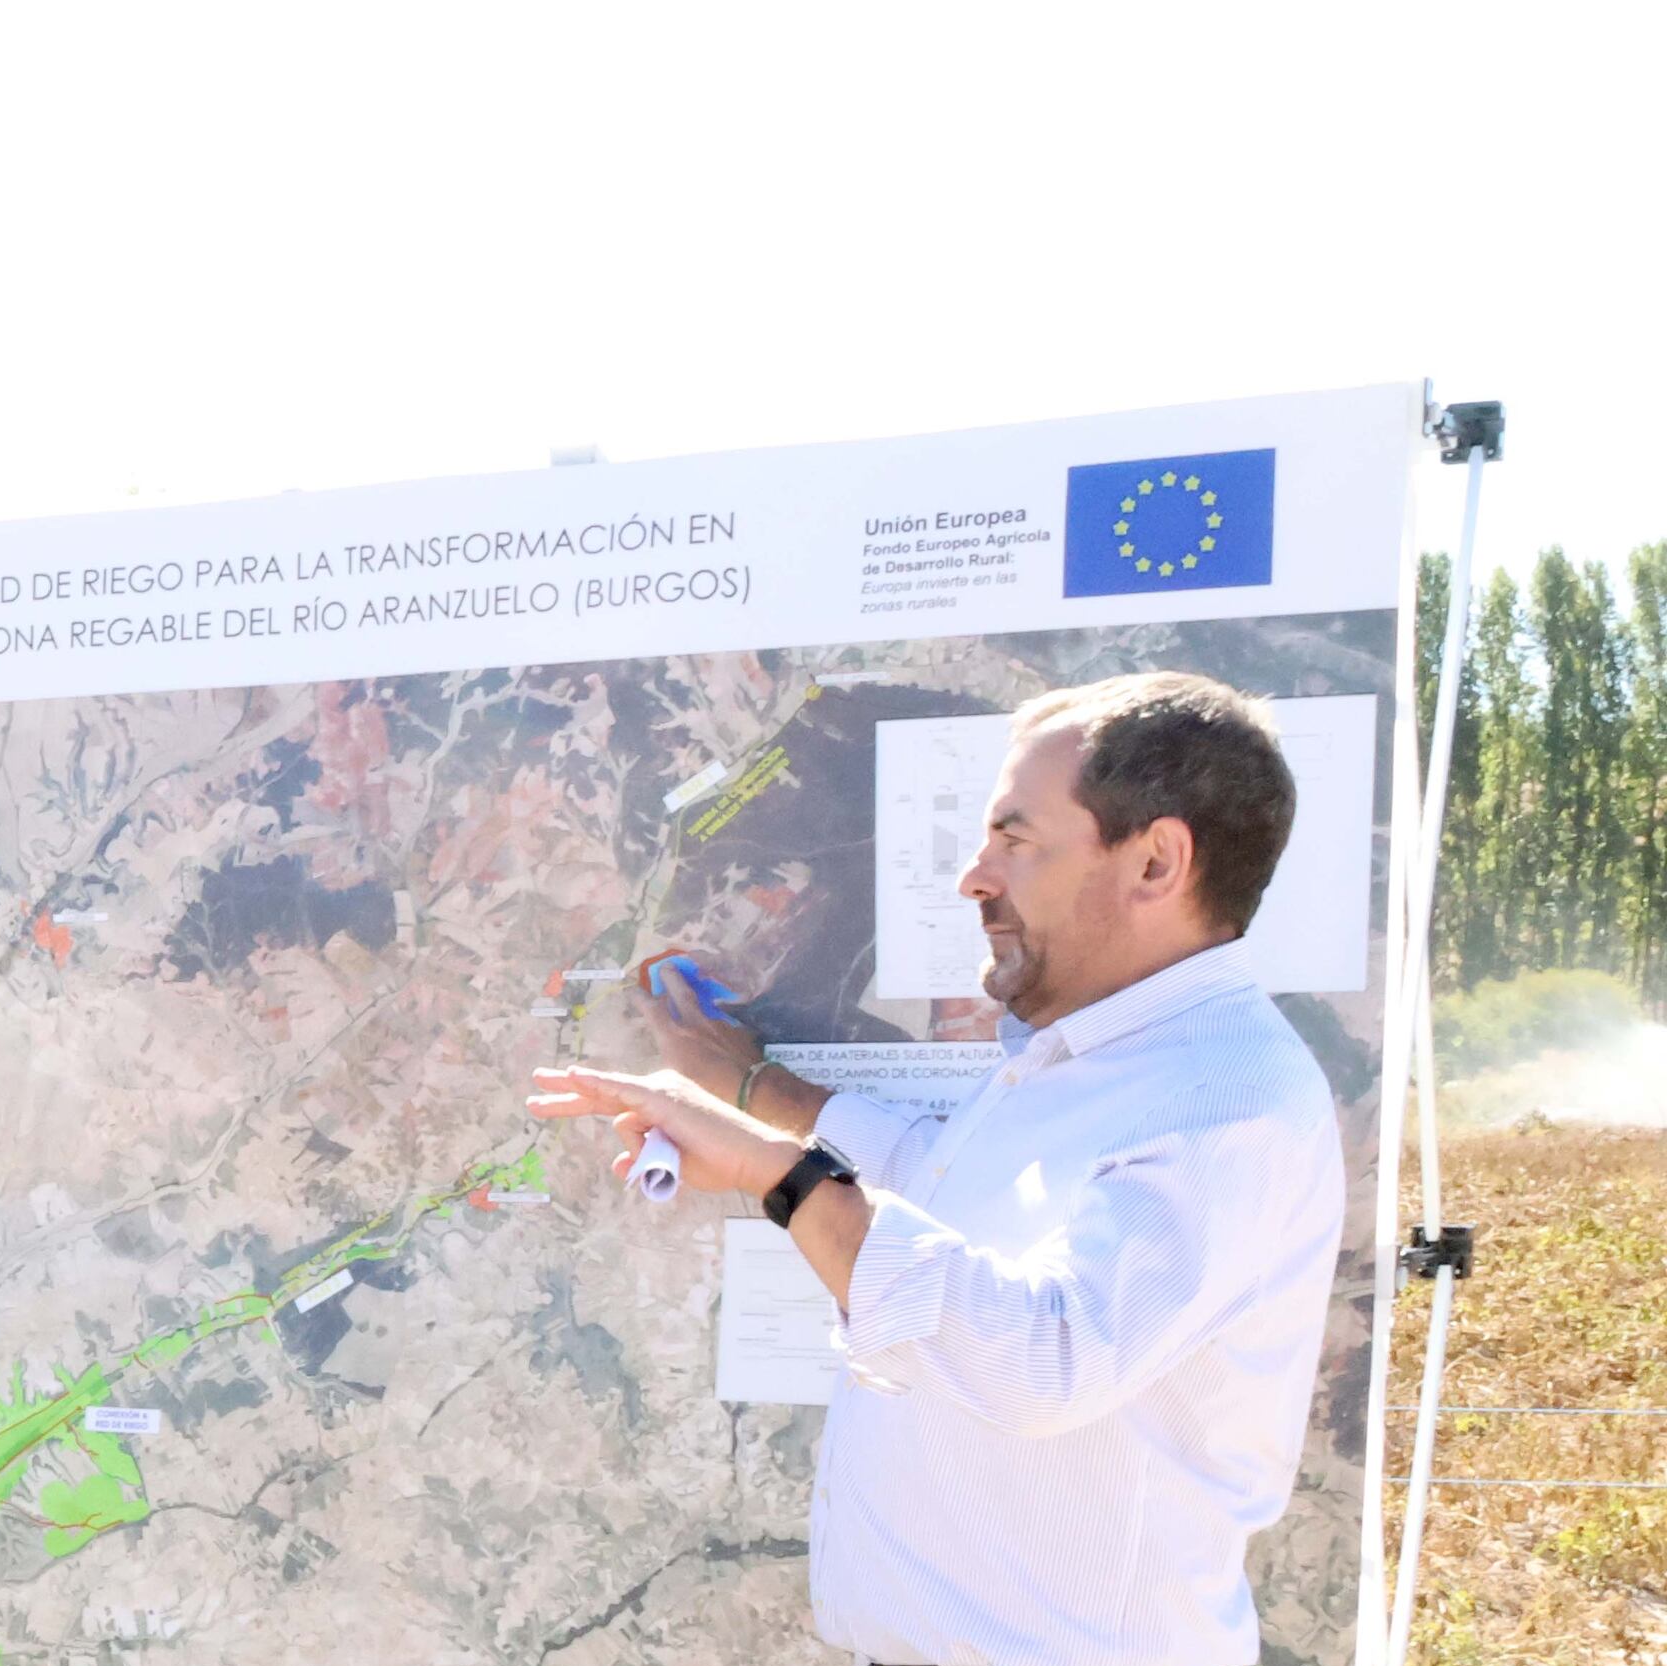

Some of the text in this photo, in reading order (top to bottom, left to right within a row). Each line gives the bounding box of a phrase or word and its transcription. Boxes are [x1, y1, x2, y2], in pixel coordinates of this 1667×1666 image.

[865, 508, 1027, 536] Unión Europea
[863, 528, 1051, 557] Fondo Europeo Agrícola
[32, 571, 71, 601] DE
[82, 562, 184, 596] RIEGO
[195, 556, 284, 588] PARA
[297, 552, 333, 581] LA
[344, 513, 674, 575] TRANSFORMACIÓN
[689, 512, 734, 544] EN
[863, 552, 1015, 576] de Desarrollo Rural:
[861, 571, 1017, 595] Europa invierte en las
[69, 611, 210, 649] REGABLE
[223, 606, 281, 638] DEL
[293, 597, 346, 632] RÍO
[358, 582, 559, 628] ARANZUELO
[574, 565, 751, 617] (BURGOS)
[860, 595, 957, 614] zonas rurales
[808, 1050, 824, 1062] DE
[828, 1049, 899, 1061] MATERIALES
[904, 1049, 953, 1060] SUELTOS
[958, 1048, 1003, 1060] ALTURA
[834, 1067, 887, 1079] CAMINO
[892, 1067, 908, 1079] DE
